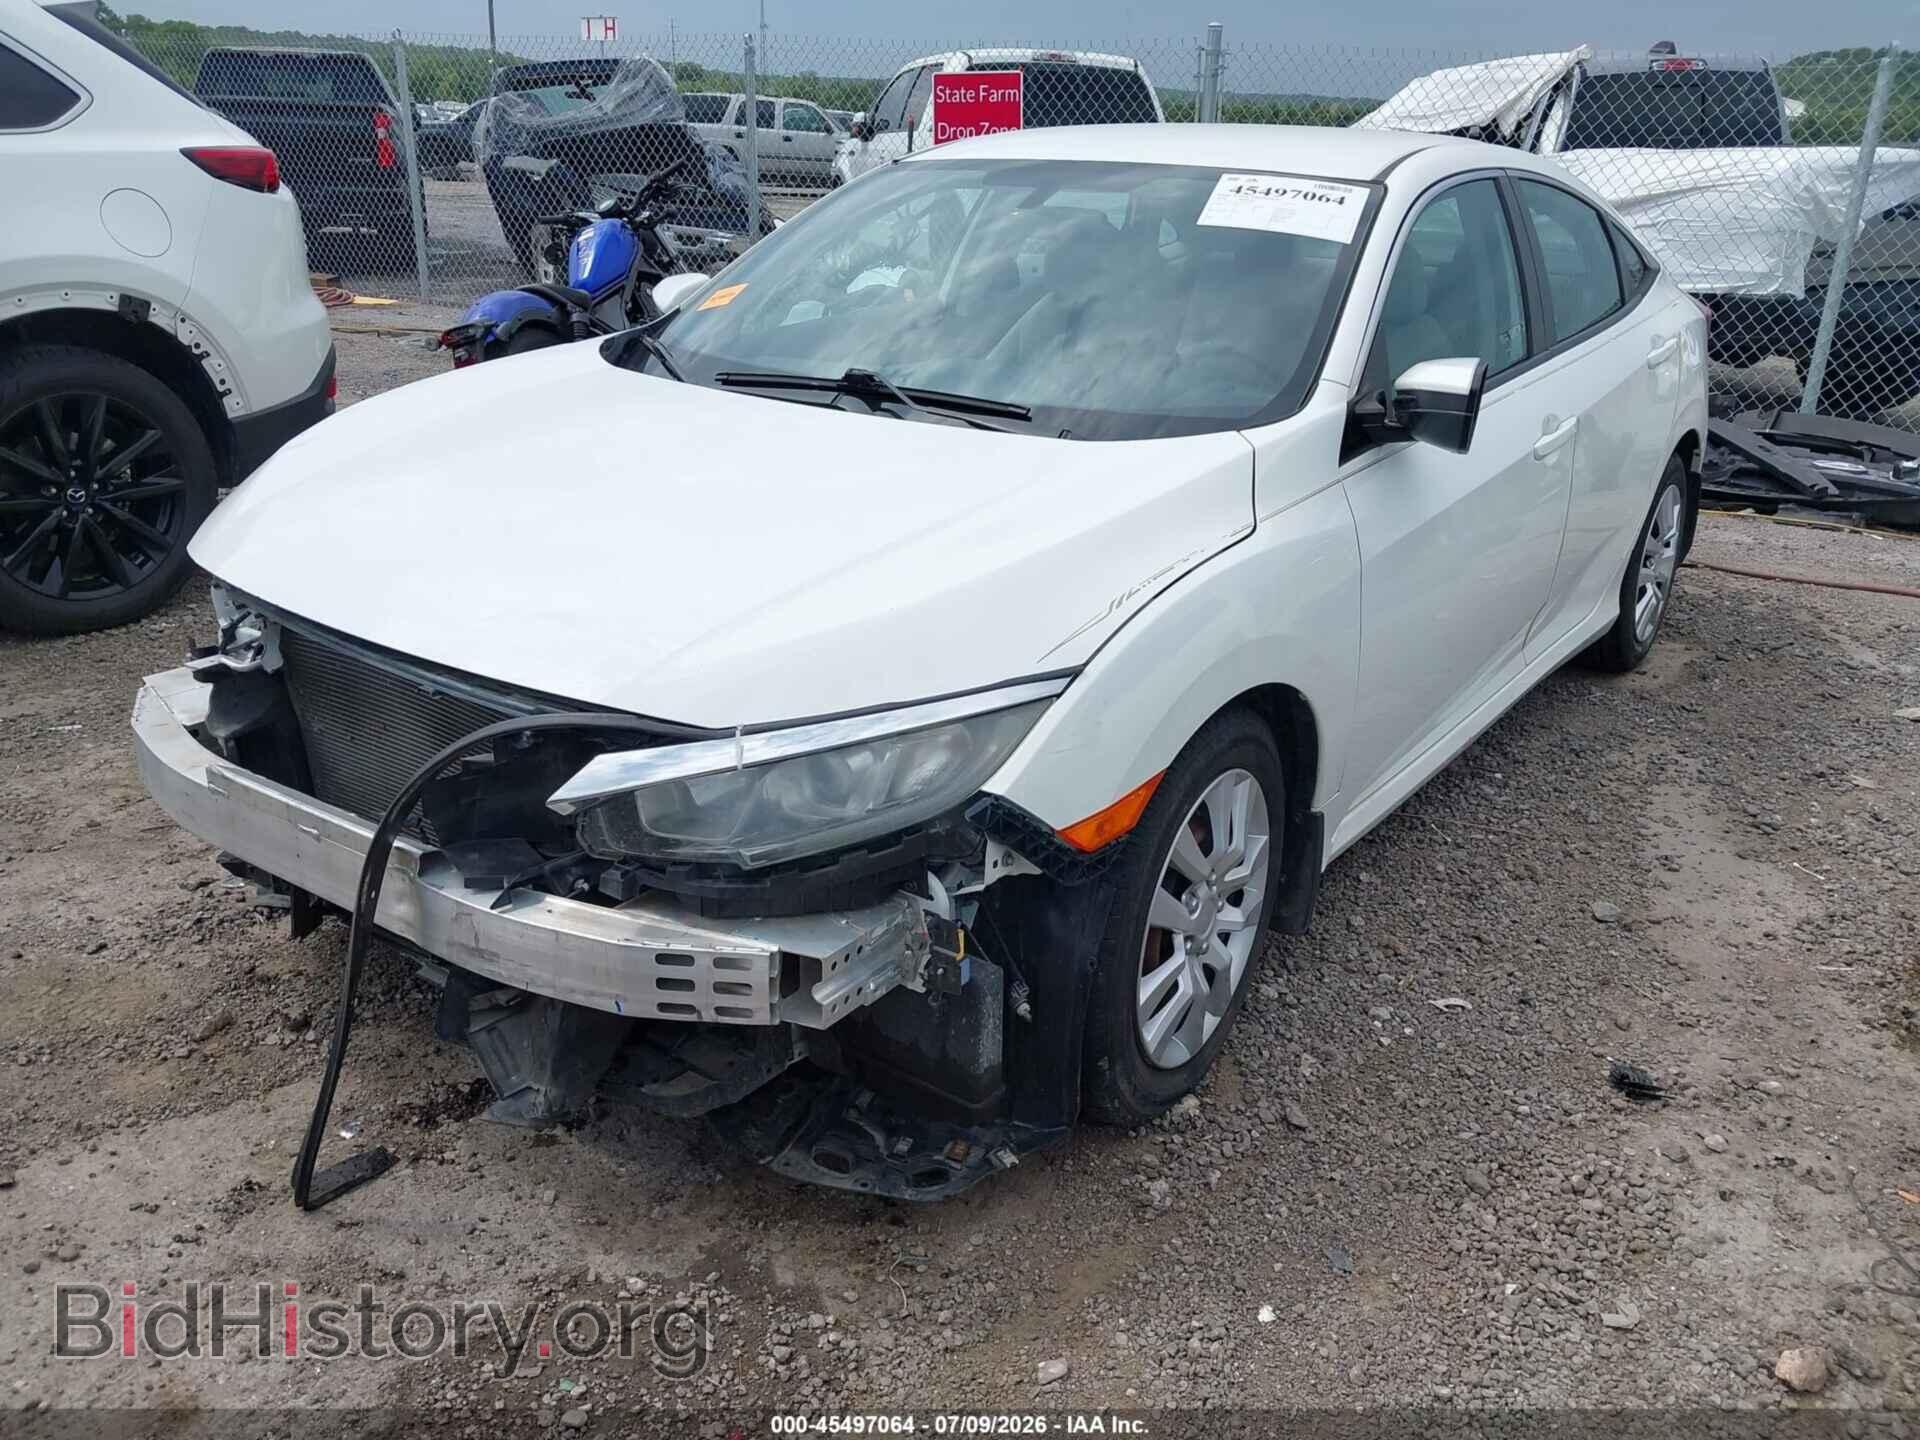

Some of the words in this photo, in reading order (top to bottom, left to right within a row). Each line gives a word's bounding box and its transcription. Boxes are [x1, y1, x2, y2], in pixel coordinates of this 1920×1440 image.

[935, 84, 976, 103] State
[979, 84, 1019, 103] Farm
[1229, 184, 1346, 206] 45497064
